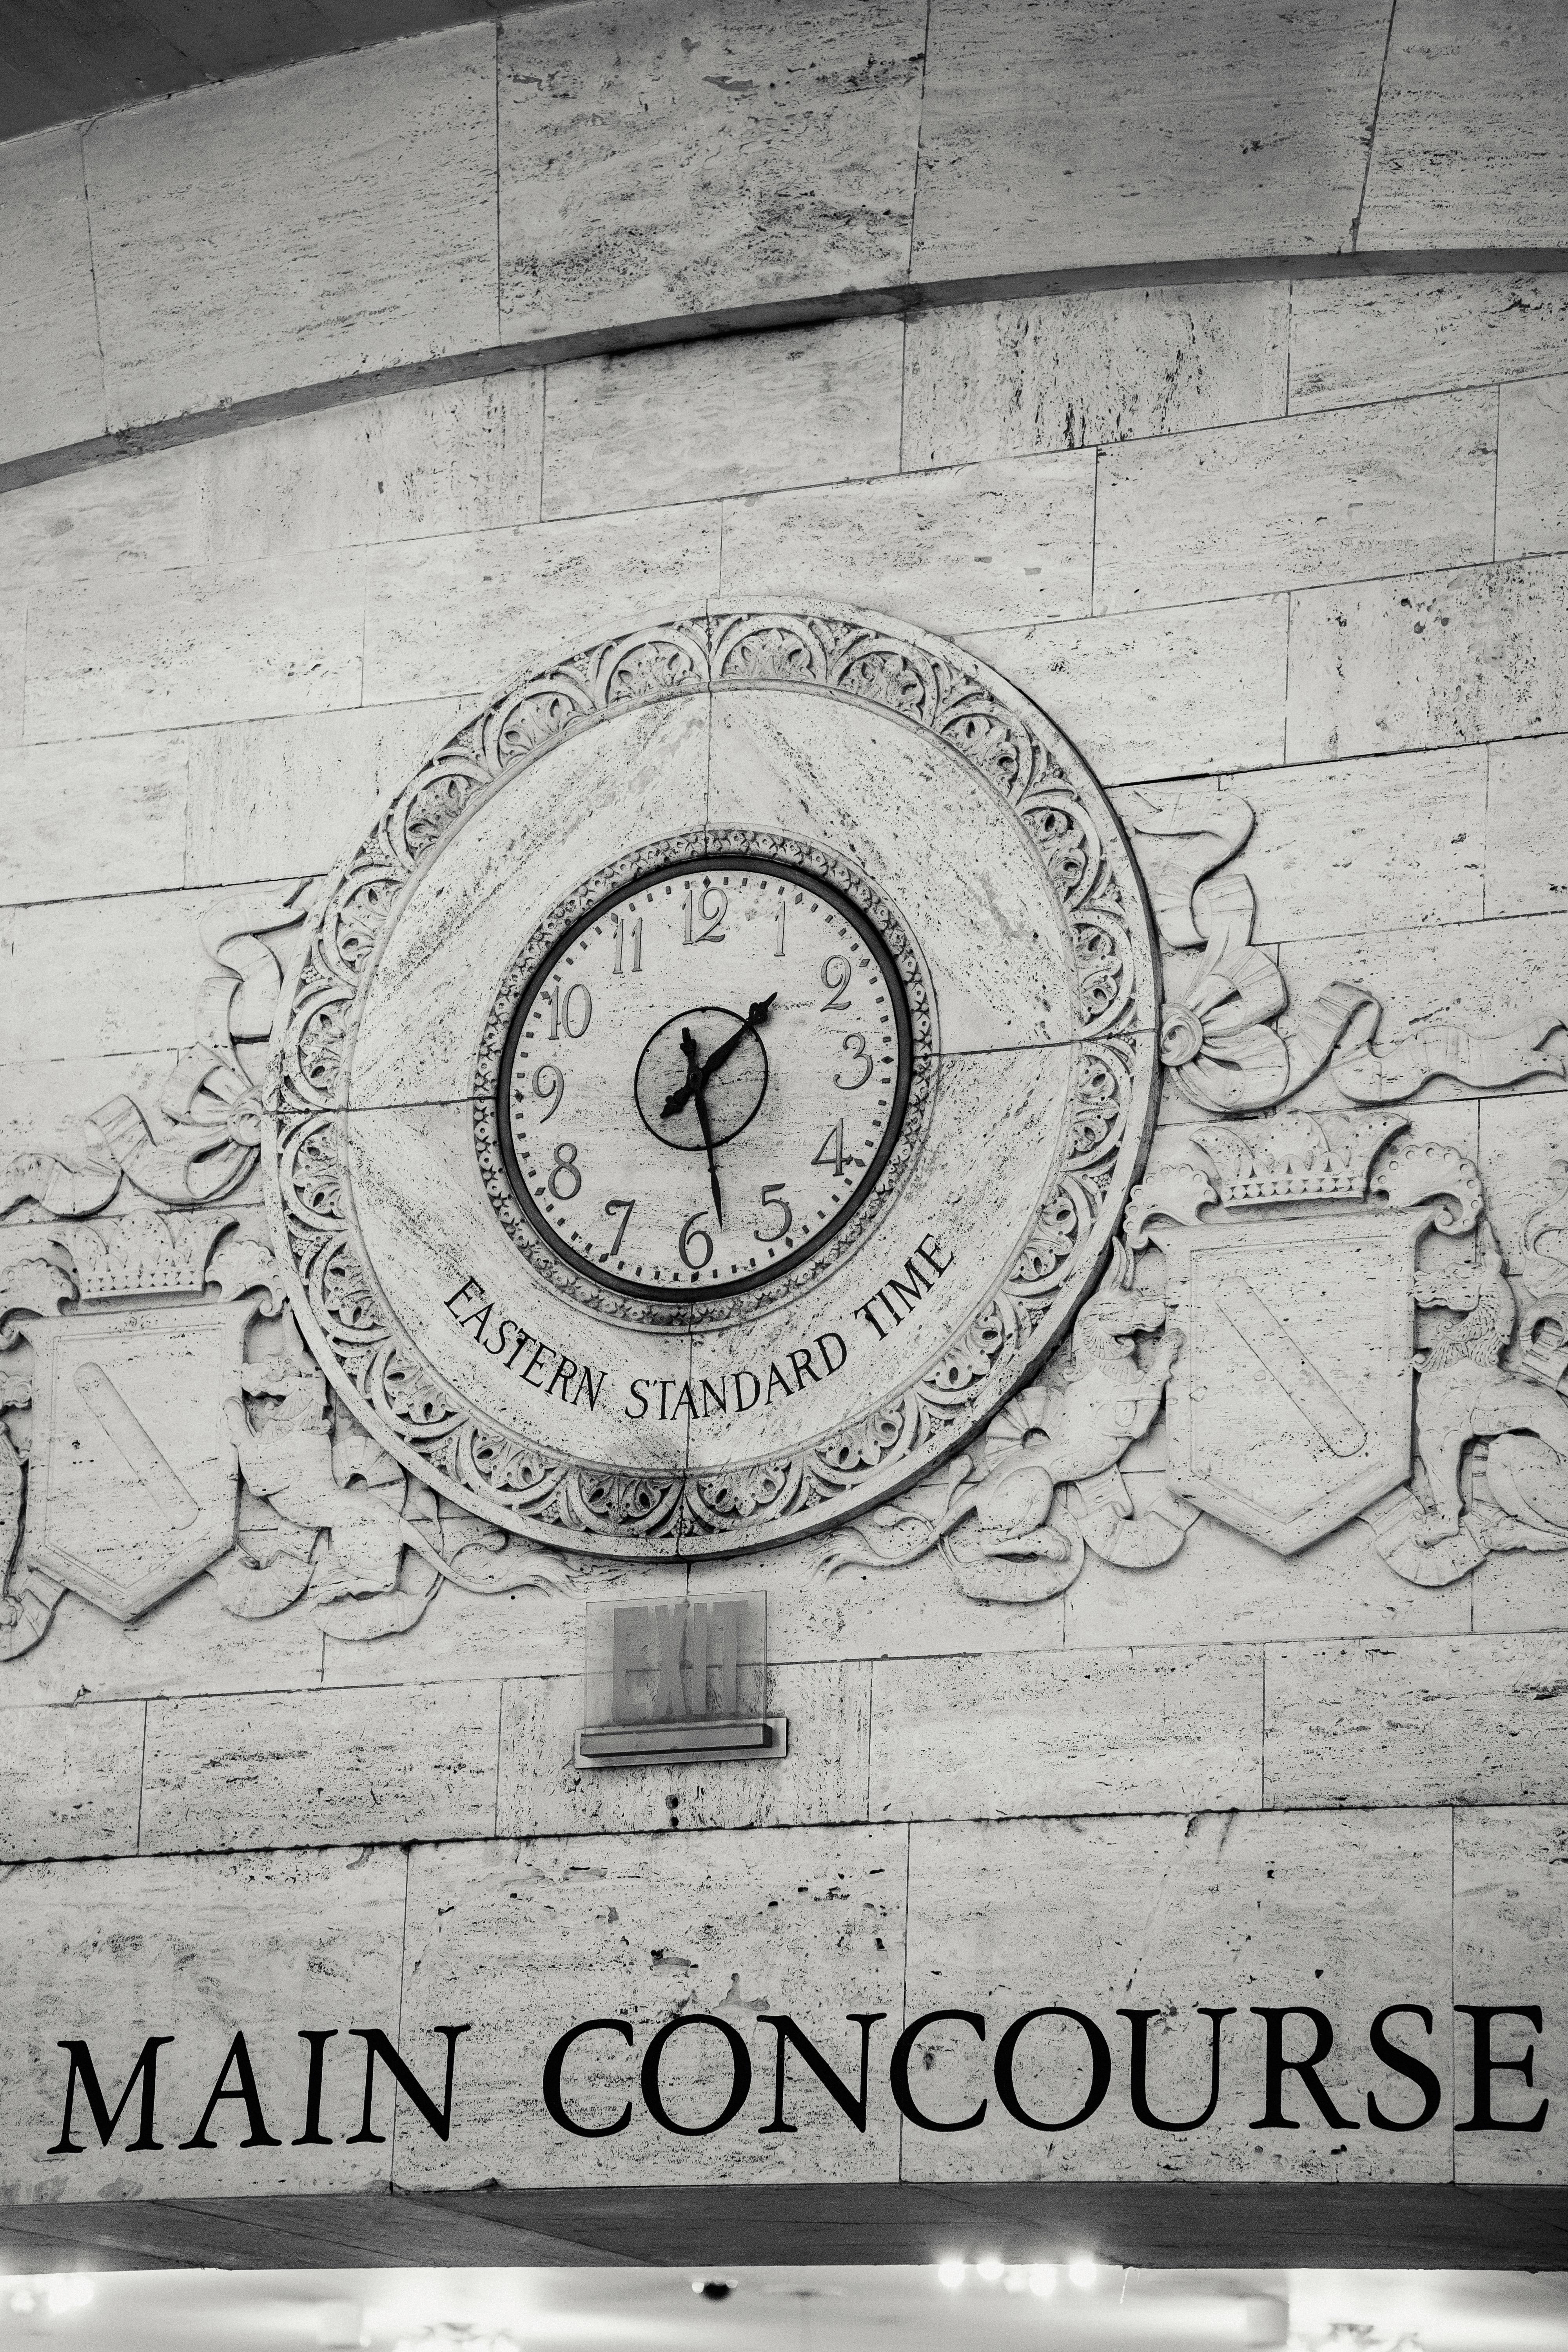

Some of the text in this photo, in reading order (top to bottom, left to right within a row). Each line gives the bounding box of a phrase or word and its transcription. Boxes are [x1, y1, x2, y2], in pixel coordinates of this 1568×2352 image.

[682, 887, 728, 945] 12
[774, 901, 786, 956] 1
[613, 917, 642, 974] 11
[548, 984, 592, 1040] 10
[820, 955, 852, 1012] 2
[833, 1033, 873, 1089] 3
[532, 1064, 564, 1123] 9
[548, 1143, 582, 1199] 8
[811, 1118, 854, 1176] 4
[604, 1199, 635, 1255] 7
[679, 1211, 713, 1269] 6
[754, 1183, 792, 1241] 5
[444, 1232, 956, 1420] EASTERN STANDARD TIME
[46, 2004, 1549, 2155] MAIN CONCOURSE
